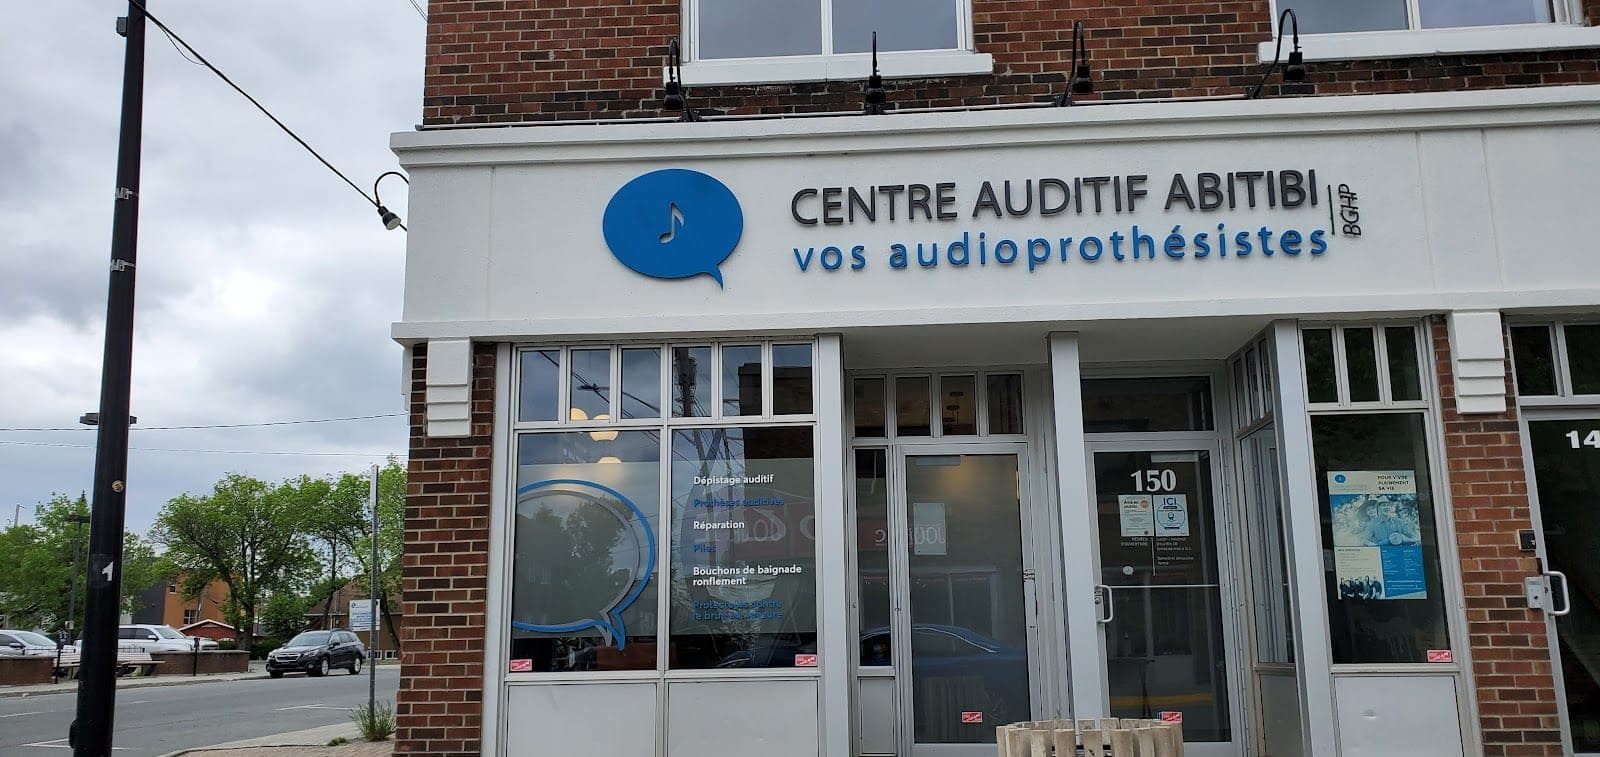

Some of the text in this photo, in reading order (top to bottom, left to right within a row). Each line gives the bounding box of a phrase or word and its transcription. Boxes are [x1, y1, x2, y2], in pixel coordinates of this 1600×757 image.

[791, 168, 1318, 225] CENTRE AUDITIF ABITIBI
[1338, 183, 1362, 238] BGHP
[793, 222, 1328, 273] vos audioprothésistes
[693, 473, 775, 486] Dépistage auditif
[1130, 469, 1177, 492] 150
[1163, 496, 1177, 506] ICI
[693, 520, 745, 531] Réparation
[693, 543, 717, 553] Piles
[693, 564, 802, 576] Bouchons de baignade
[692, 576, 747, 586] ronflement
